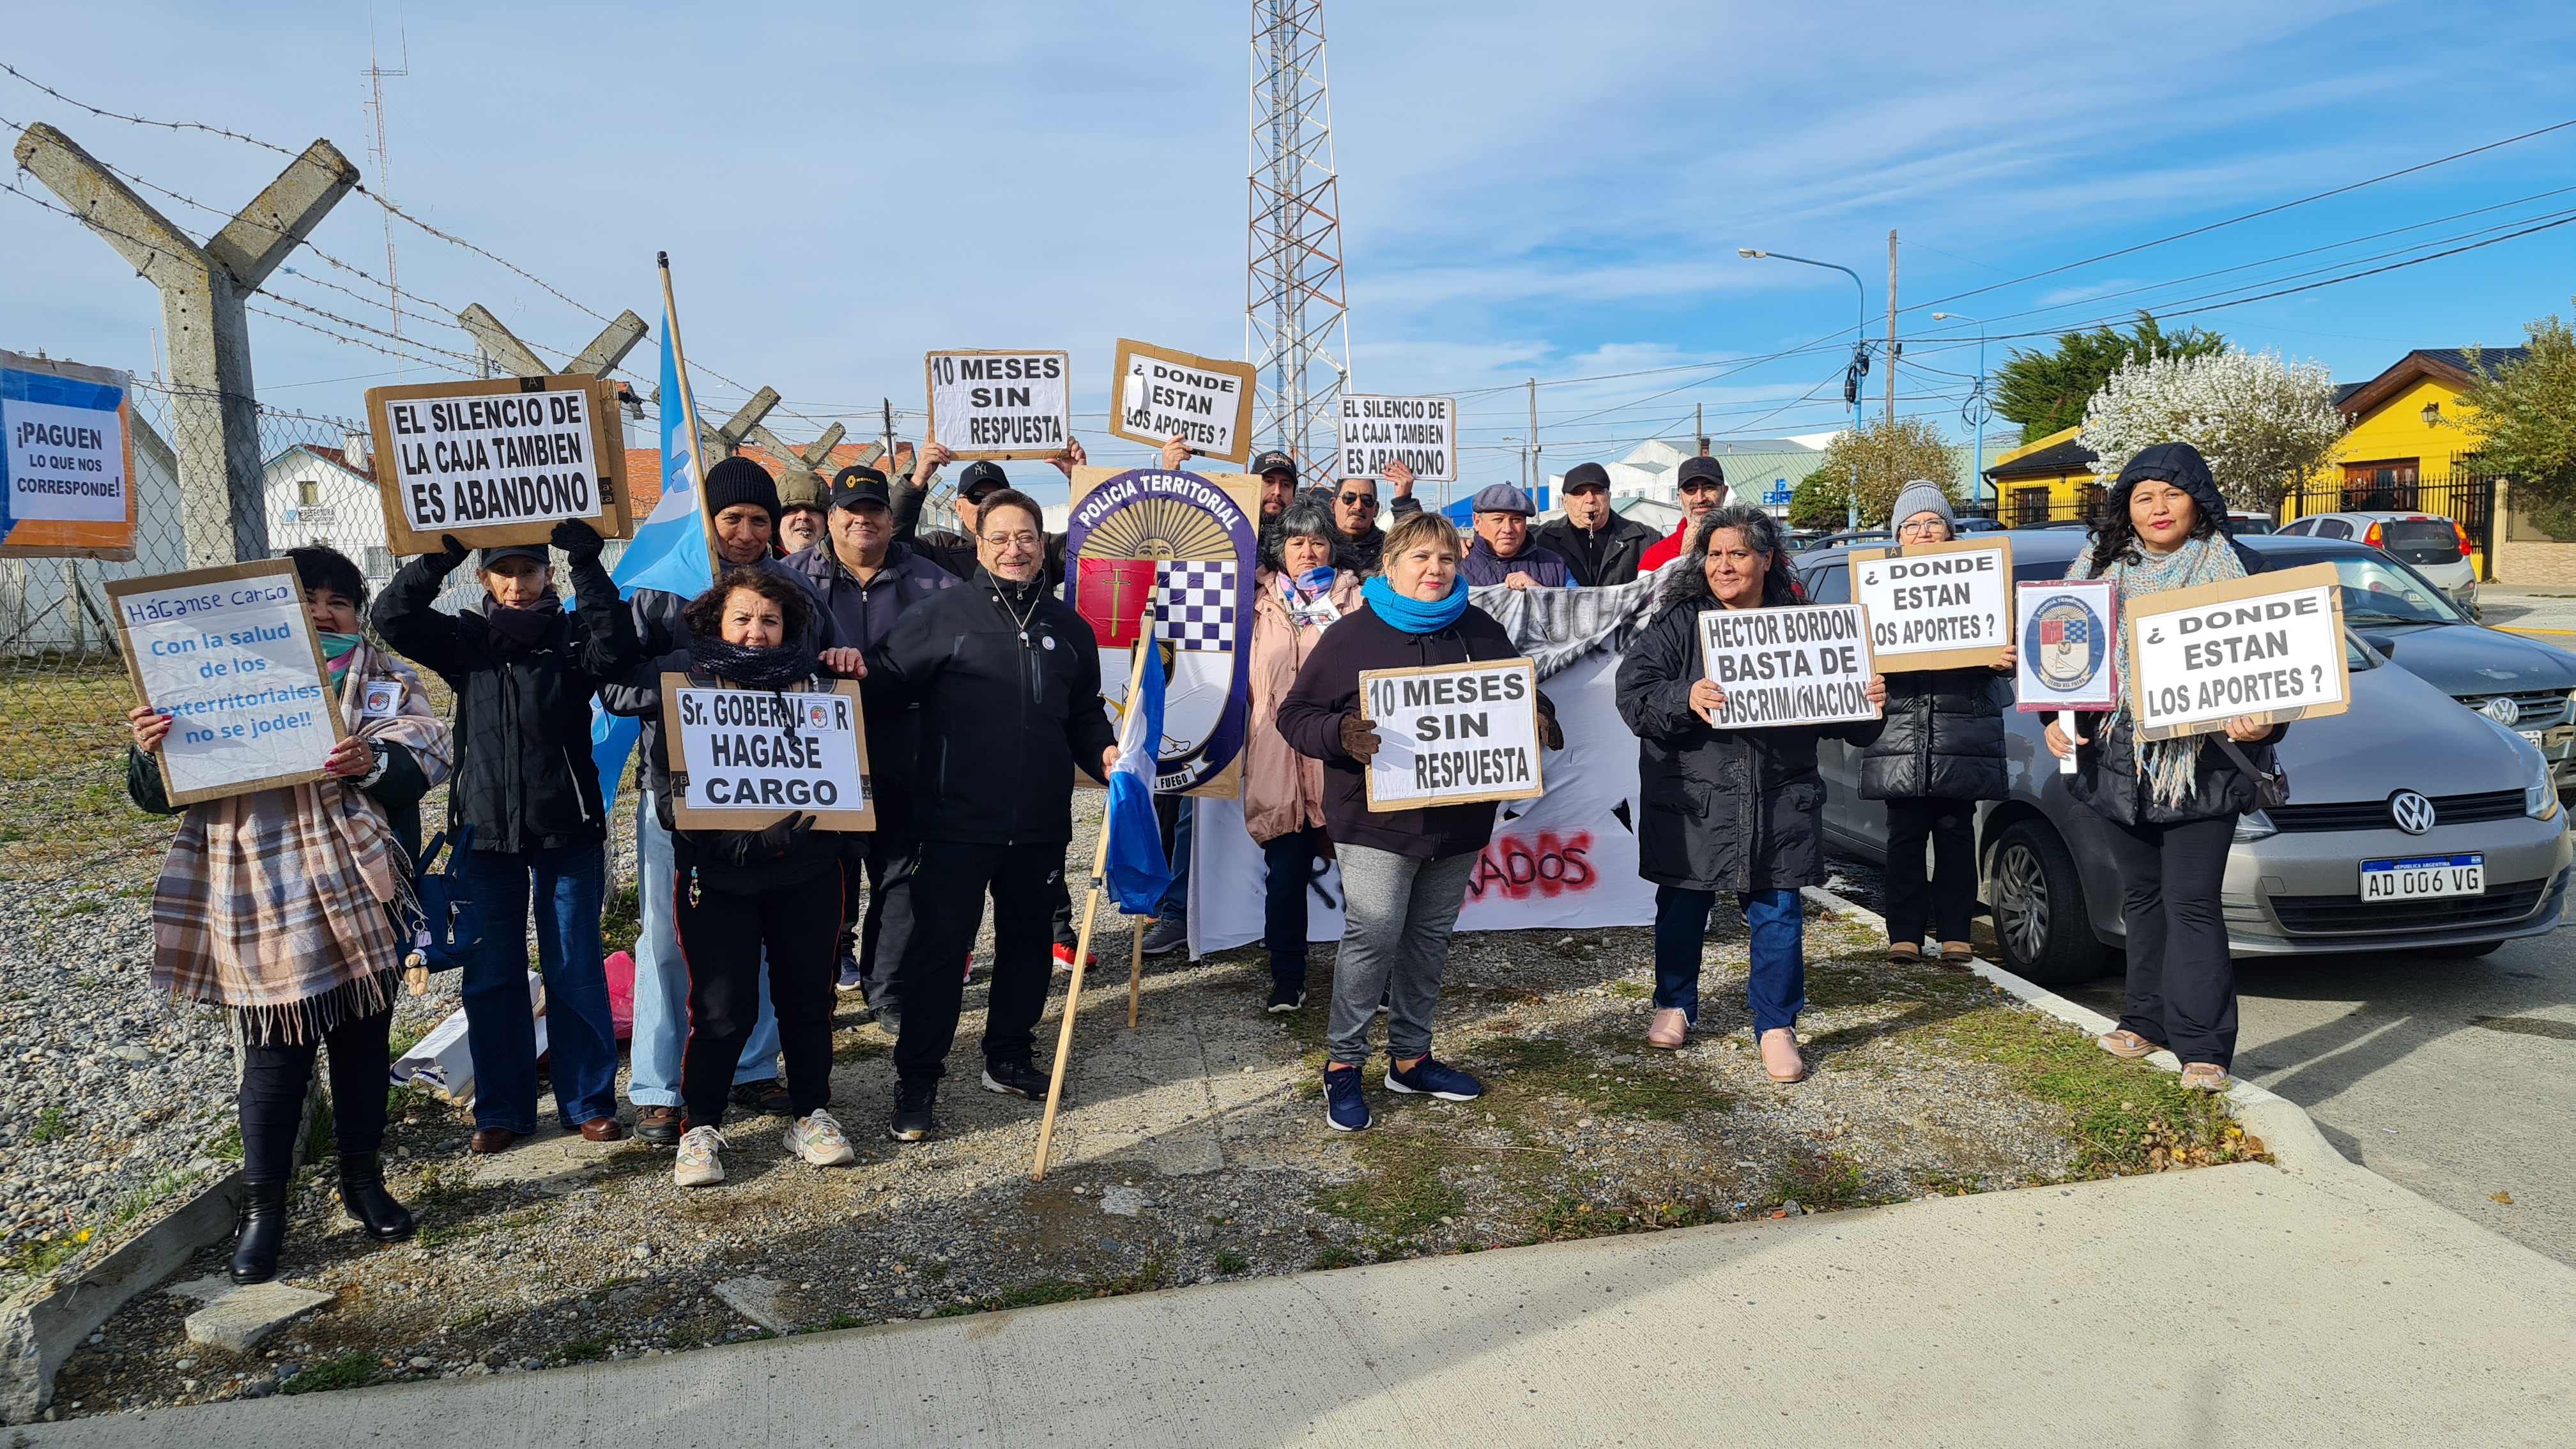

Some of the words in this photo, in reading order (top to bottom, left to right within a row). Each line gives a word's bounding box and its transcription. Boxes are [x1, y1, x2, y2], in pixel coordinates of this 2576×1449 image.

[933, 357, 954, 385] 10
[960, 358, 1060, 380] MESES
[1153, 367, 1235, 394] DONDE
[970, 387, 1030, 408] SIN
[1152, 385, 1212, 415] ESTAN
[1344, 400, 1359, 418] EL
[1363, 400, 1424, 419] SILENCIO
[1429, 401, 1445, 419] DE
[394, 405, 425, 434] EL
[432, 398, 543, 433] SILENCIO
[550, 395, 581, 425] DE
[970, 415, 1062, 444] RESPUESTA
[1126, 406, 1151, 430] LOS
[1154, 413, 1215, 444] APORTES
[17, 421, 102, 450] ¡PAGUEN
[1345, 423, 1360, 443] LA
[1363, 423, 1392, 443] CAJA
[1395, 424, 1443, 445] TAMBIEN
[30, 454, 46, 468] LO
[50, 456, 75, 471] QUE
[78, 457, 102, 472] NOS
[402, 443, 431, 475] LA
[435, 439, 490, 473] CAJA
[492, 433, 582, 469] TAMBIEN
[1347, 448, 1363, 474] ES
[17, 476, 120, 498] CORRESPONDE!
[411, 483, 445, 524] ES
[455, 472, 588, 521] ABANDONO
[1078, 480, 1138, 528] POLICIA
[1140, 475, 1240, 531] TERRITORIAL
[1890, 556, 1994, 579] DONDE
[1894, 582, 1970, 611] ESTAN
[1708, 615, 1781, 648] HECTOR
[1784, 609, 1858, 643] BORDON
[1873, 622, 1897, 647] OS
[1903, 614, 1981, 644] APORTES
[2179, 595, 2319, 635] DONDE
[151, 640, 196, 656] Con
[202, 633, 224, 649] la
[230, 622, 291, 645] salud
[2184, 630, 2288, 670] ESTAN
[199, 662, 227, 678] de
[233, 657, 266, 675] los
[1718, 650, 1813, 682] BASTA
[1820, 646, 1858, 675] DE
[157, 684, 321, 717] exterritoriales
[1370, 679, 1395, 717] 10
[1403, 673, 1525, 707] MESES
[2148, 685, 2189, 717] LOS
[2198, 667, 2304, 710] APORTES
[185, 729, 214, 744] no
[221, 724, 245, 739] se
[251, 711, 312, 739] jode!!
[682, 694, 707, 725] Sr.
[714, 694, 849, 730] GOBERNAR
[1415, 712, 1489, 741] SIN
[711, 733, 822, 769] HAGASE
[1161, 773, 1188, 788] FUEGO
[1415, 747, 1529, 789] RESPUESTA
[705, 778, 838, 806] CARGO
[1468, 848, 1588, 896] ADOS
[2369, 873, 2395, 897] AD
[2404, 870, 2443, 894] 006
[2452, 868, 2478, 891] VG
